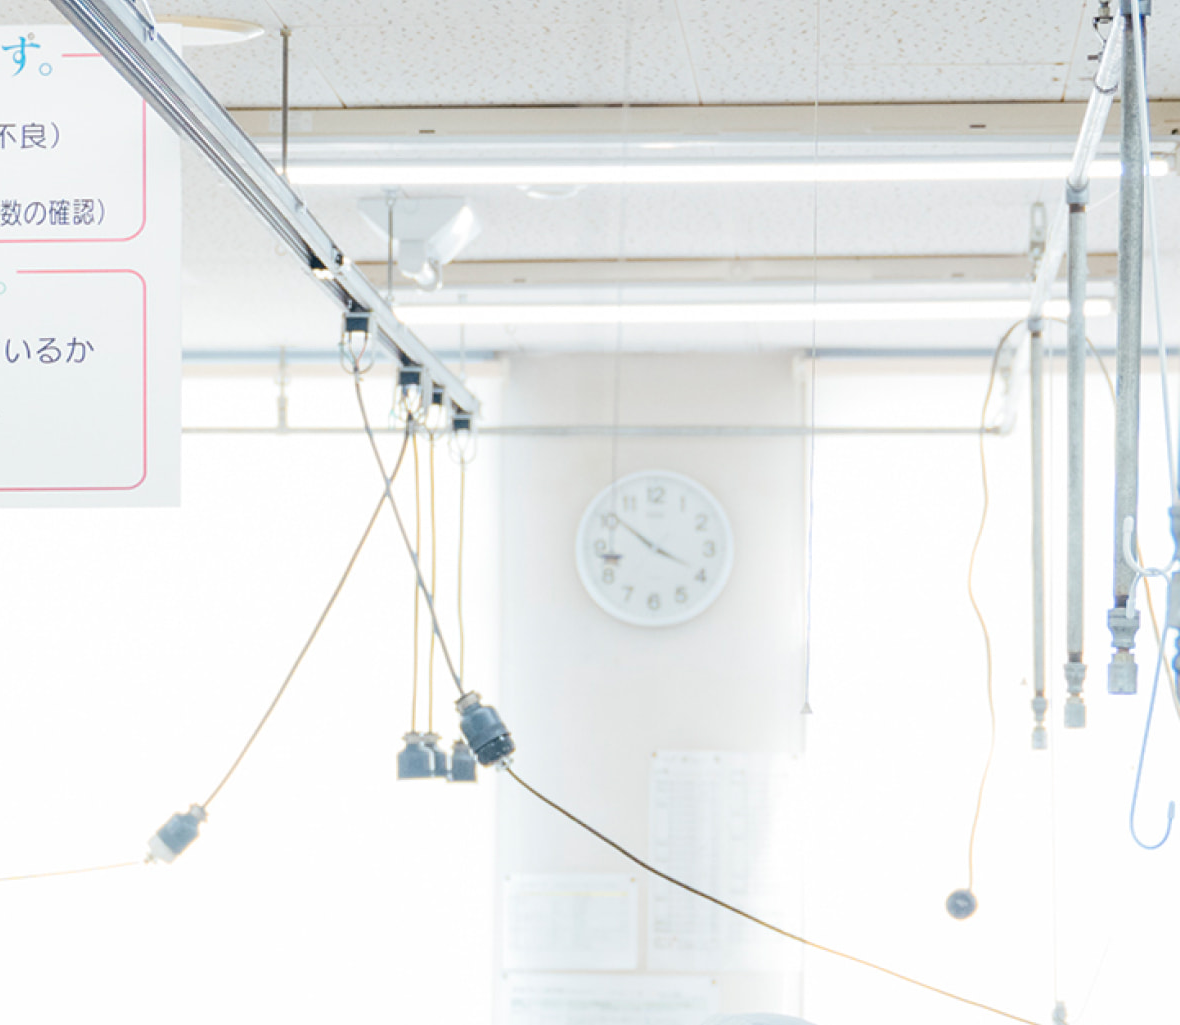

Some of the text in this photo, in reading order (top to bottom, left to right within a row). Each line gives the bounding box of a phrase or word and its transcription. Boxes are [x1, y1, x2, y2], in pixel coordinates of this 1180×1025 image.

[647, 486, 666, 504] 12
[601, 513, 620, 530] 10
[695, 513, 709, 532] 2
[703, 540, 716, 558] 3
[602, 567, 615, 584] 8
[695, 568, 707, 583] 4
[623, 586, 634, 601] 7
[647, 594, 661, 610] 6
[675, 587, 688, 603] 5
